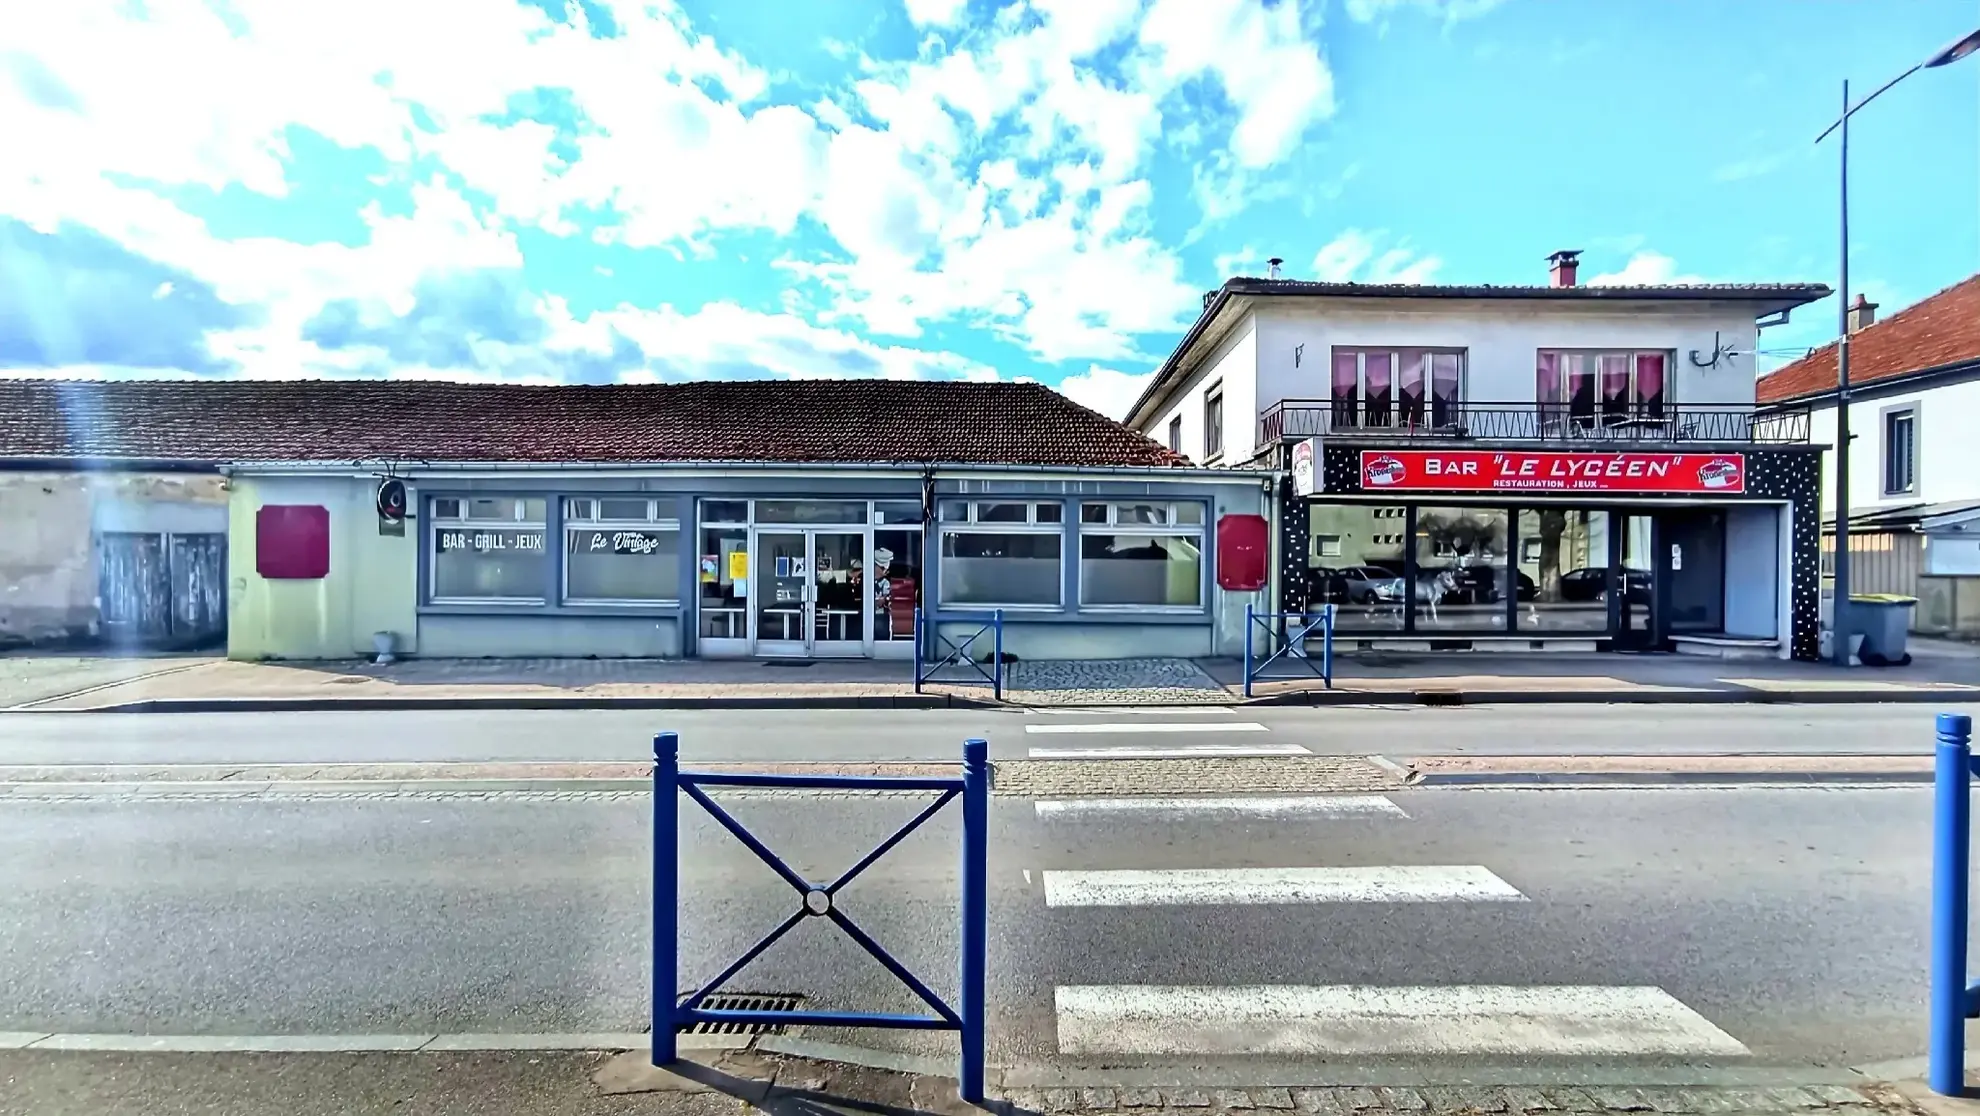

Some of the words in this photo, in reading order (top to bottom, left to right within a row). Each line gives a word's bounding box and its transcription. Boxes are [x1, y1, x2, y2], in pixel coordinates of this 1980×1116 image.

[1425, 458, 1478, 475] BAR
[442, 533, 466, 549] BAR
[475, 534, 506, 549] GRILL
[514, 534, 542, 549] JEUX
[590, 532, 608, 551] Le
[612, 531, 659, 554] Vintage
